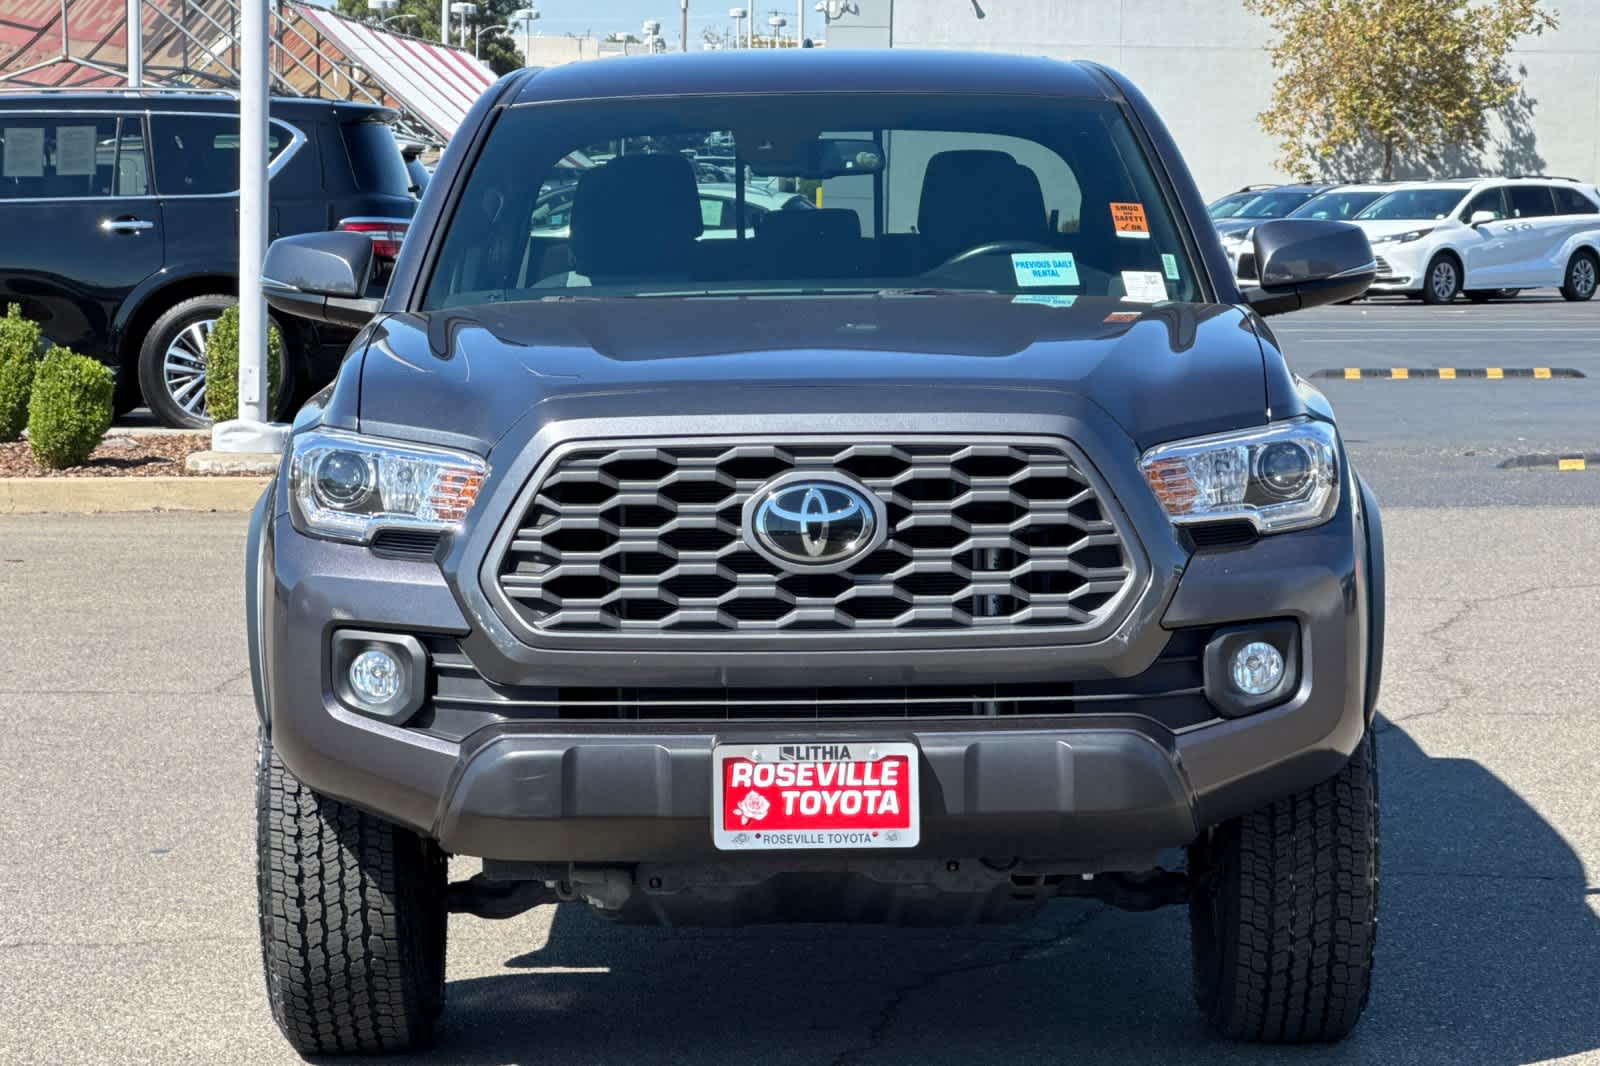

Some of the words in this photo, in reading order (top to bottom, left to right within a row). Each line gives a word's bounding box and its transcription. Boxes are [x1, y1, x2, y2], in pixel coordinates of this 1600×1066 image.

[1015, 261, 1051, 269] PREVIOUS
[1053, 260, 1072, 268] DAILY
[1032, 269, 1060, 277] RENTAL
[796, 746, 852, 761] LITHIA
[731, 761, 900, 788] ROSEVILLE
[781, 790, 900, 816] TOYOTA
[763, 833, 824, 845] ROSEVILLE
[829, 832, 872, 844] TOYOTA
